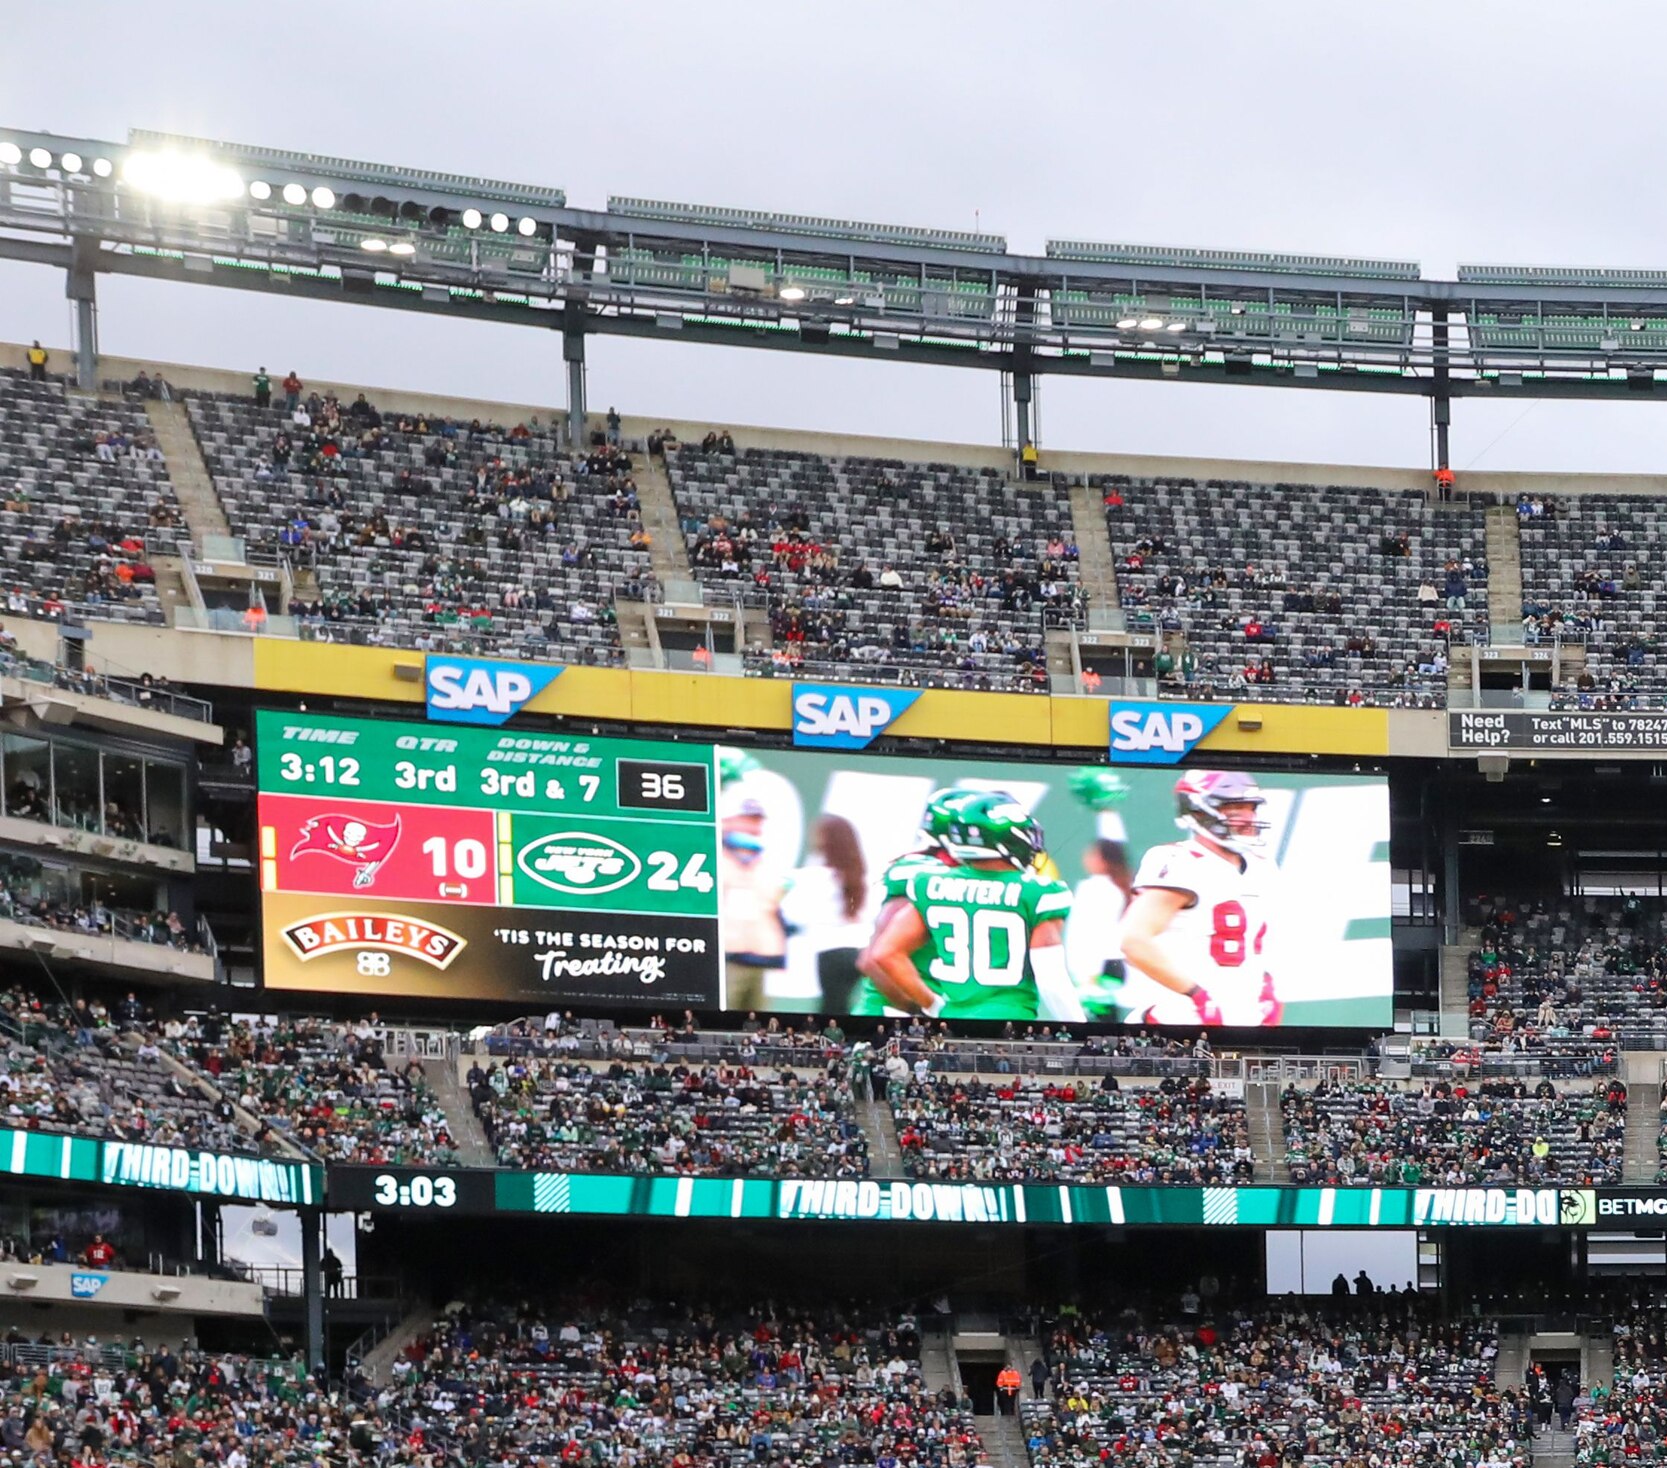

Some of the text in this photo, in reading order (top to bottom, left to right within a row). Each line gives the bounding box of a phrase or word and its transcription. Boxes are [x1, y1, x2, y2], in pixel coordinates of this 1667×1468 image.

[429, 666, 532, 714] SAP
[796, 692, 891, 738] SAP
[1112, 708, 1202, 752] SAP
[1461, 714, 1505, 729] Need
[1531, 718, 1562, 731] Text
[1612, 719, 1626, 731] to
[282, 725, 361, 746] TIME
[396, 736, 459, 754] QTR
[497, 737, 571, 753] DOWN
[1461, 729, 1511, 746] Help?
[1532, 733, 1548, 744] or
[1550, 732, 1576, 744] call
[280, 752, 361, 787] 3:12
[486, 750, 603, 768] DISTANCE
[395, 761, 457, 793] 3rd
[480, 767, 600, 802] 3rd & 7
[640, 772, 685, 800] 36
[422, 835, 487, 880] 10
[646, 850, 714, 893] 24
[926, 876, 1003, 906] CARTER
[293, 918, 450, 957] BAILEYS
[535, 930, 574, 948] THE
[579, 933, 660, 951] SEASON
[664, 936, 707, 954] FOR
[926, 905, 1027, 987] 30
[534, 950, 667, 984] Treating
[102, 1141, 191, 1190] THIRD
[375, 1174, 457, 1207] 3:03
[780, 1181, 881, 1219] THIRD
[1413, 1189, 1506, 1225] THIRD
[74, 1276, 102, 1294] SAP
